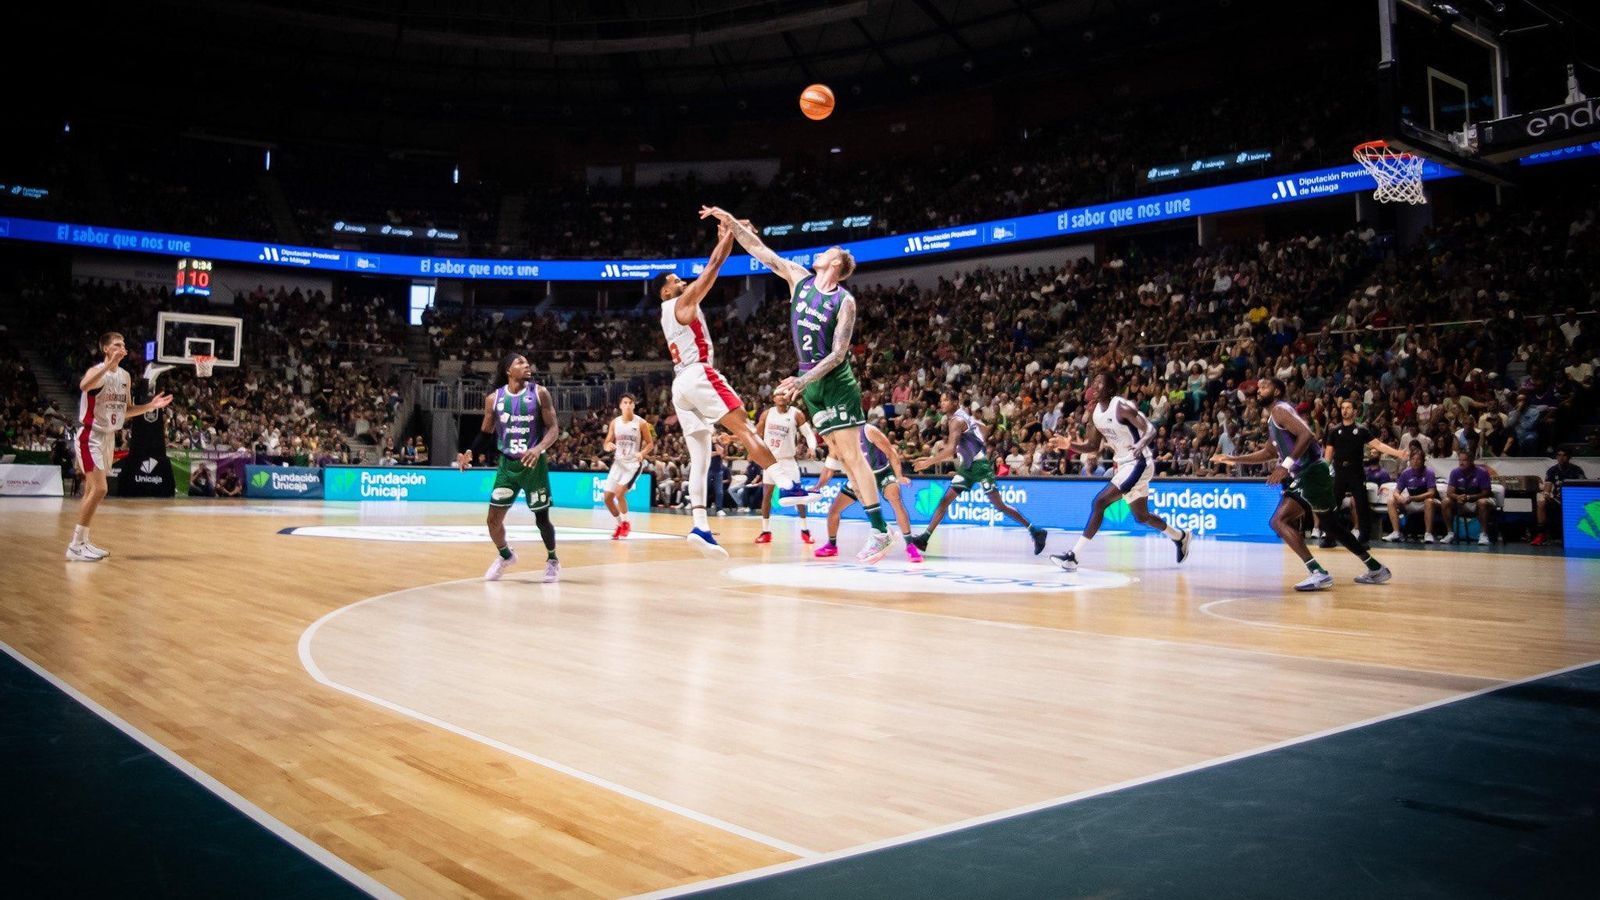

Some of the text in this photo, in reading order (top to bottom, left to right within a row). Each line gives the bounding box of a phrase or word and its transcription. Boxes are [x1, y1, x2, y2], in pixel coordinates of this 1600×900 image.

[1527, 100, 1600, 136] end
[1299, 173, 1340, 186] Diputación
[1299, 183, 1339, 195] de Málaga
[1057, 198, 1191, 230] El sabor que nos une
[57, 224, 191, 252] El sabor que nos une
[420, 259, 539, 278] El sabor que nos une
[189, 271, 209, 288] 10
[805, 307, 828, 322] Unicaja
[802, 334, 813, 351] 2
[111, 413, 117, 425] 6
[510, 414, 535, 423] Unicaja
[509, 438, 528, 454] 55
[134, 475, 163, 484] Unicaja
[272, 472, 320, 483] Fundación
[361, 471, 427, 485] Fundación
[272, 481, 308, 492] Unicaja
[361, 484, 409, 500] Unicaja
[949, 501, 1005, 526] Unicaja
[1154, 508, 1217, 534] nicaja
